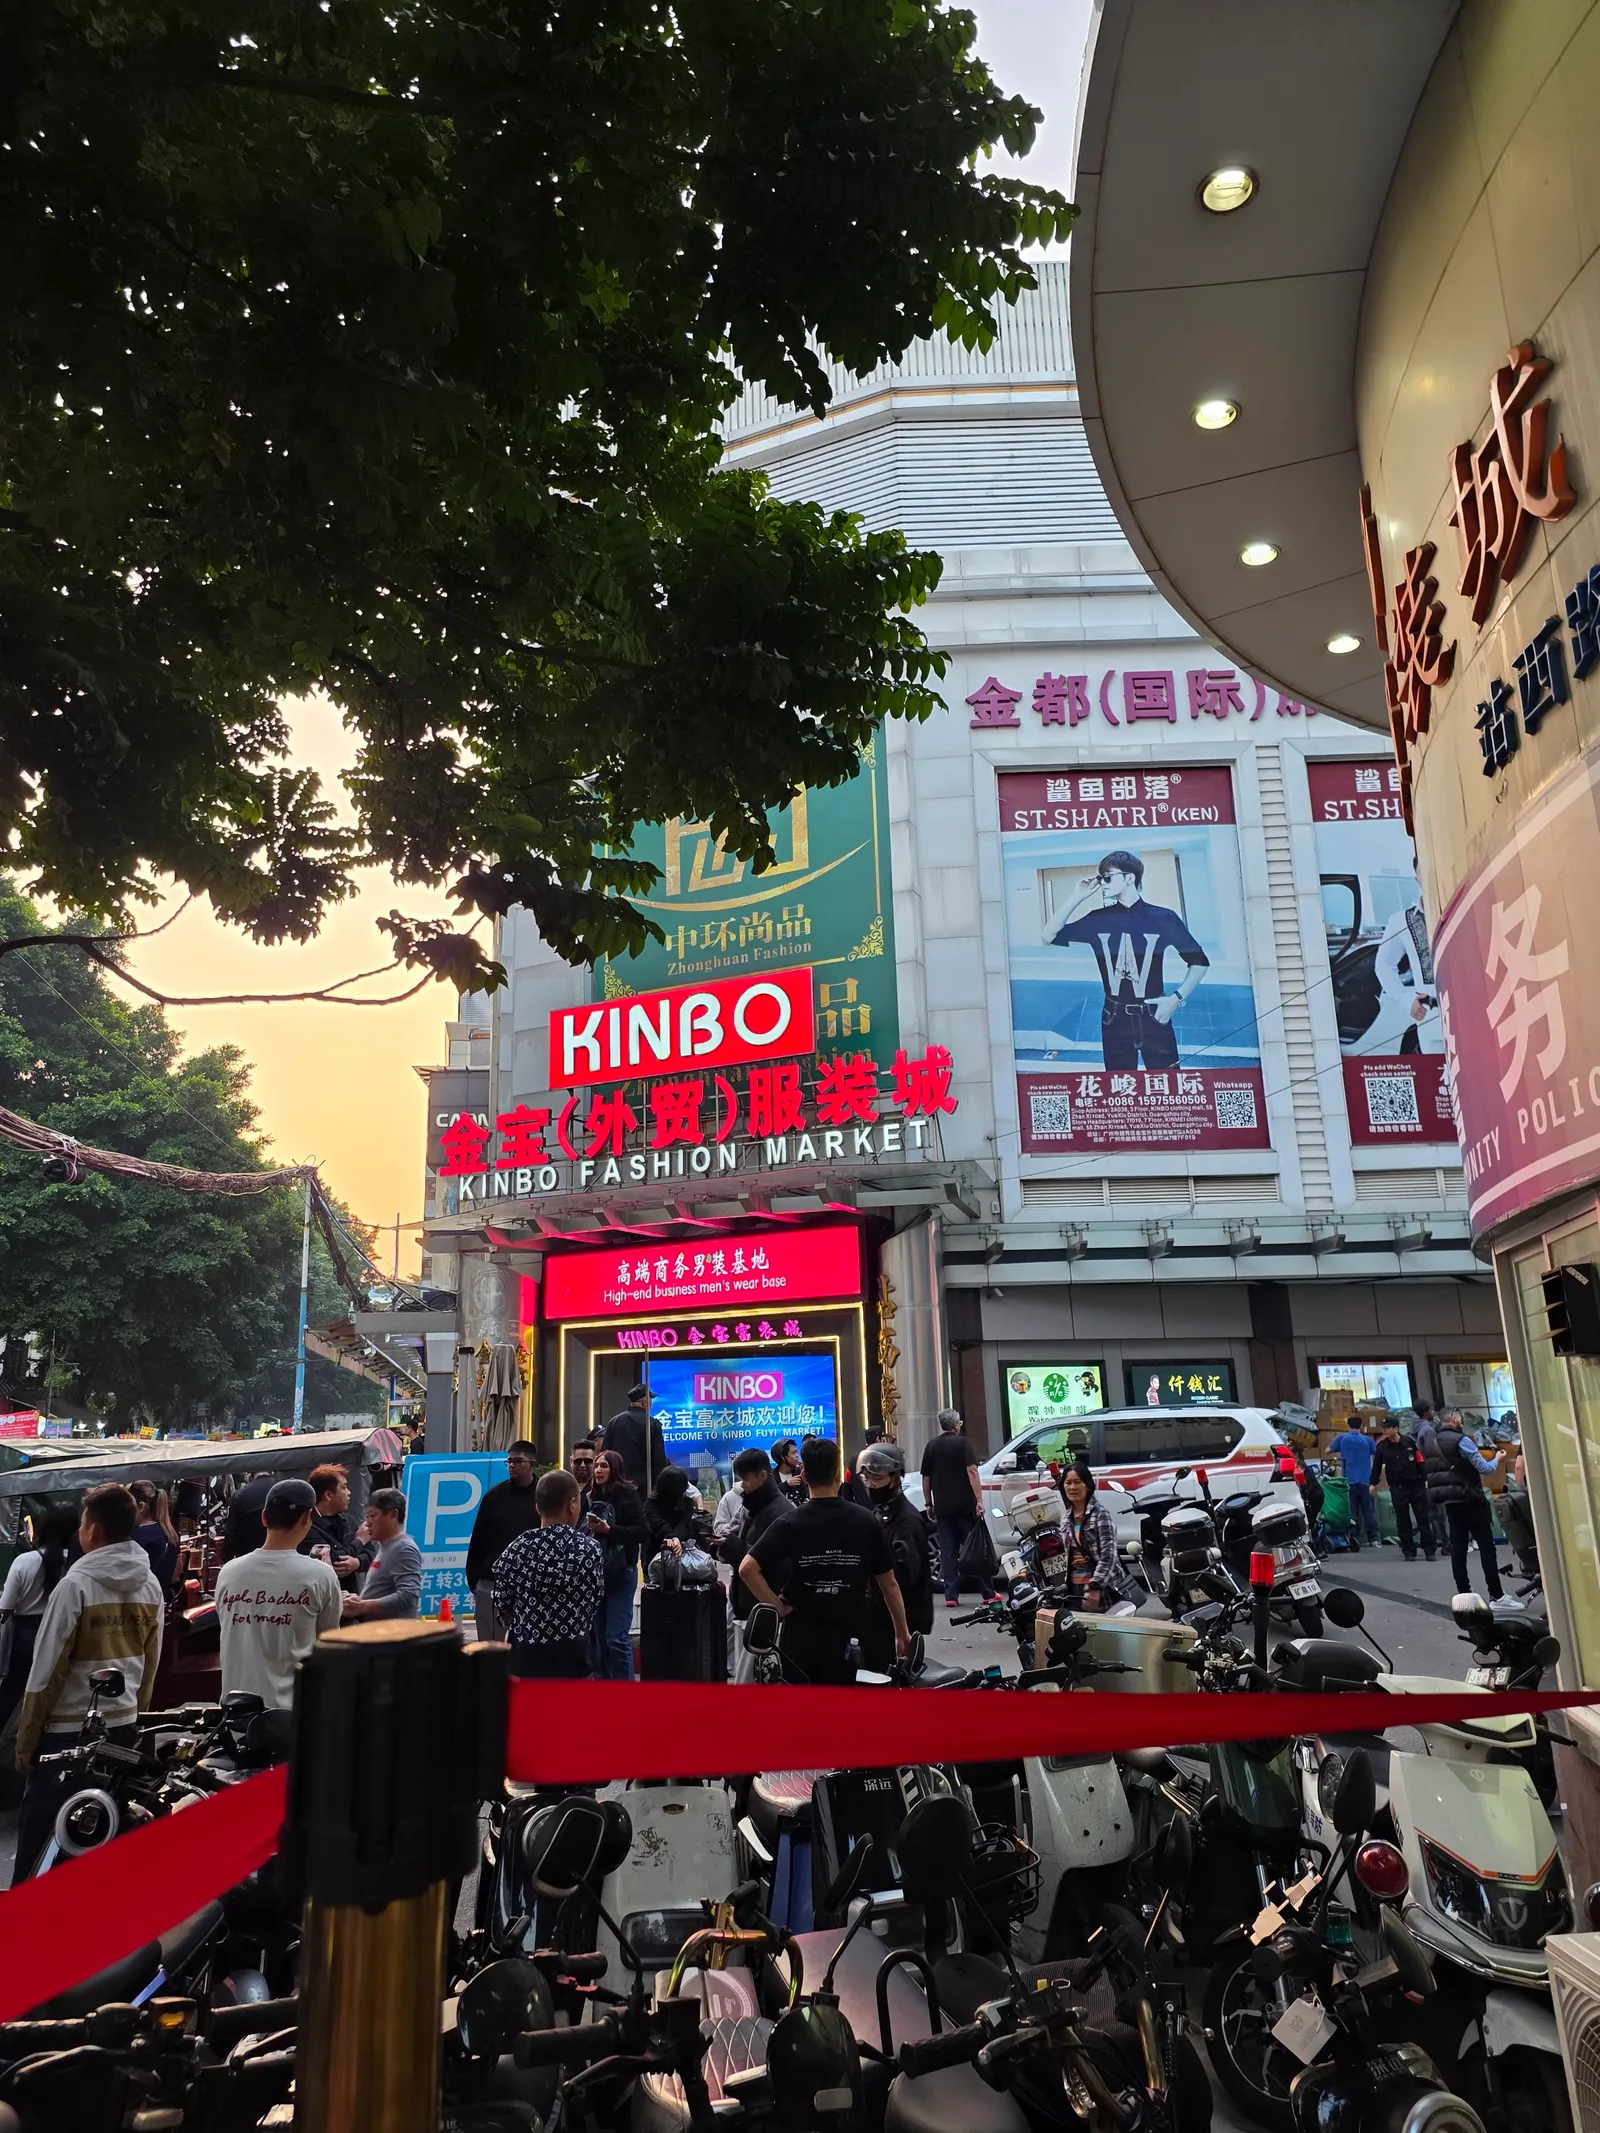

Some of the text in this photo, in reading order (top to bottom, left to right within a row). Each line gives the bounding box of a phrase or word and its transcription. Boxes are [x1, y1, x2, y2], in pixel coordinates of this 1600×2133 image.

[966, 669, 1318, 729] 金都（国际）
[1171, 805, 1219, 824] (KEN)
[665, 903, 812, 960] 中环尚品
[667, 941, 812, 977] Zhonghuan Fashion
[562, 981, 791, 1077] KINBO
[1075, 1072, 1204, 1098] 花峻国际
[1213, 1081, 1253, 1090] Whatsapp
[437, 1044, 958, 1178] 金宝（外贸）服装城
[1101, 1097, 1135, 1107] +0086
[1137, 1094, 1207, 1106] 15975560506
[459, 1118, 930, 1201] KINBO FASHION MARKET
[616, 1246, 770, 1287] 高端商务男装基地
[603, 1274, 787, 1306] High-end business men's wear base
[617, 1318, 803, 1350] KINBO 金宝富衣城
[700, 1374, 778, 1401] KINBO
[1168, 1374, 1223, 1396] 仟钱汇
[663, 1426, 825, 1443] ELCOME TO KINBO FUYI MARKET!
[416, 1592, 476, 1612] 下停车
[863, 1777, 893, 1792] 深远
